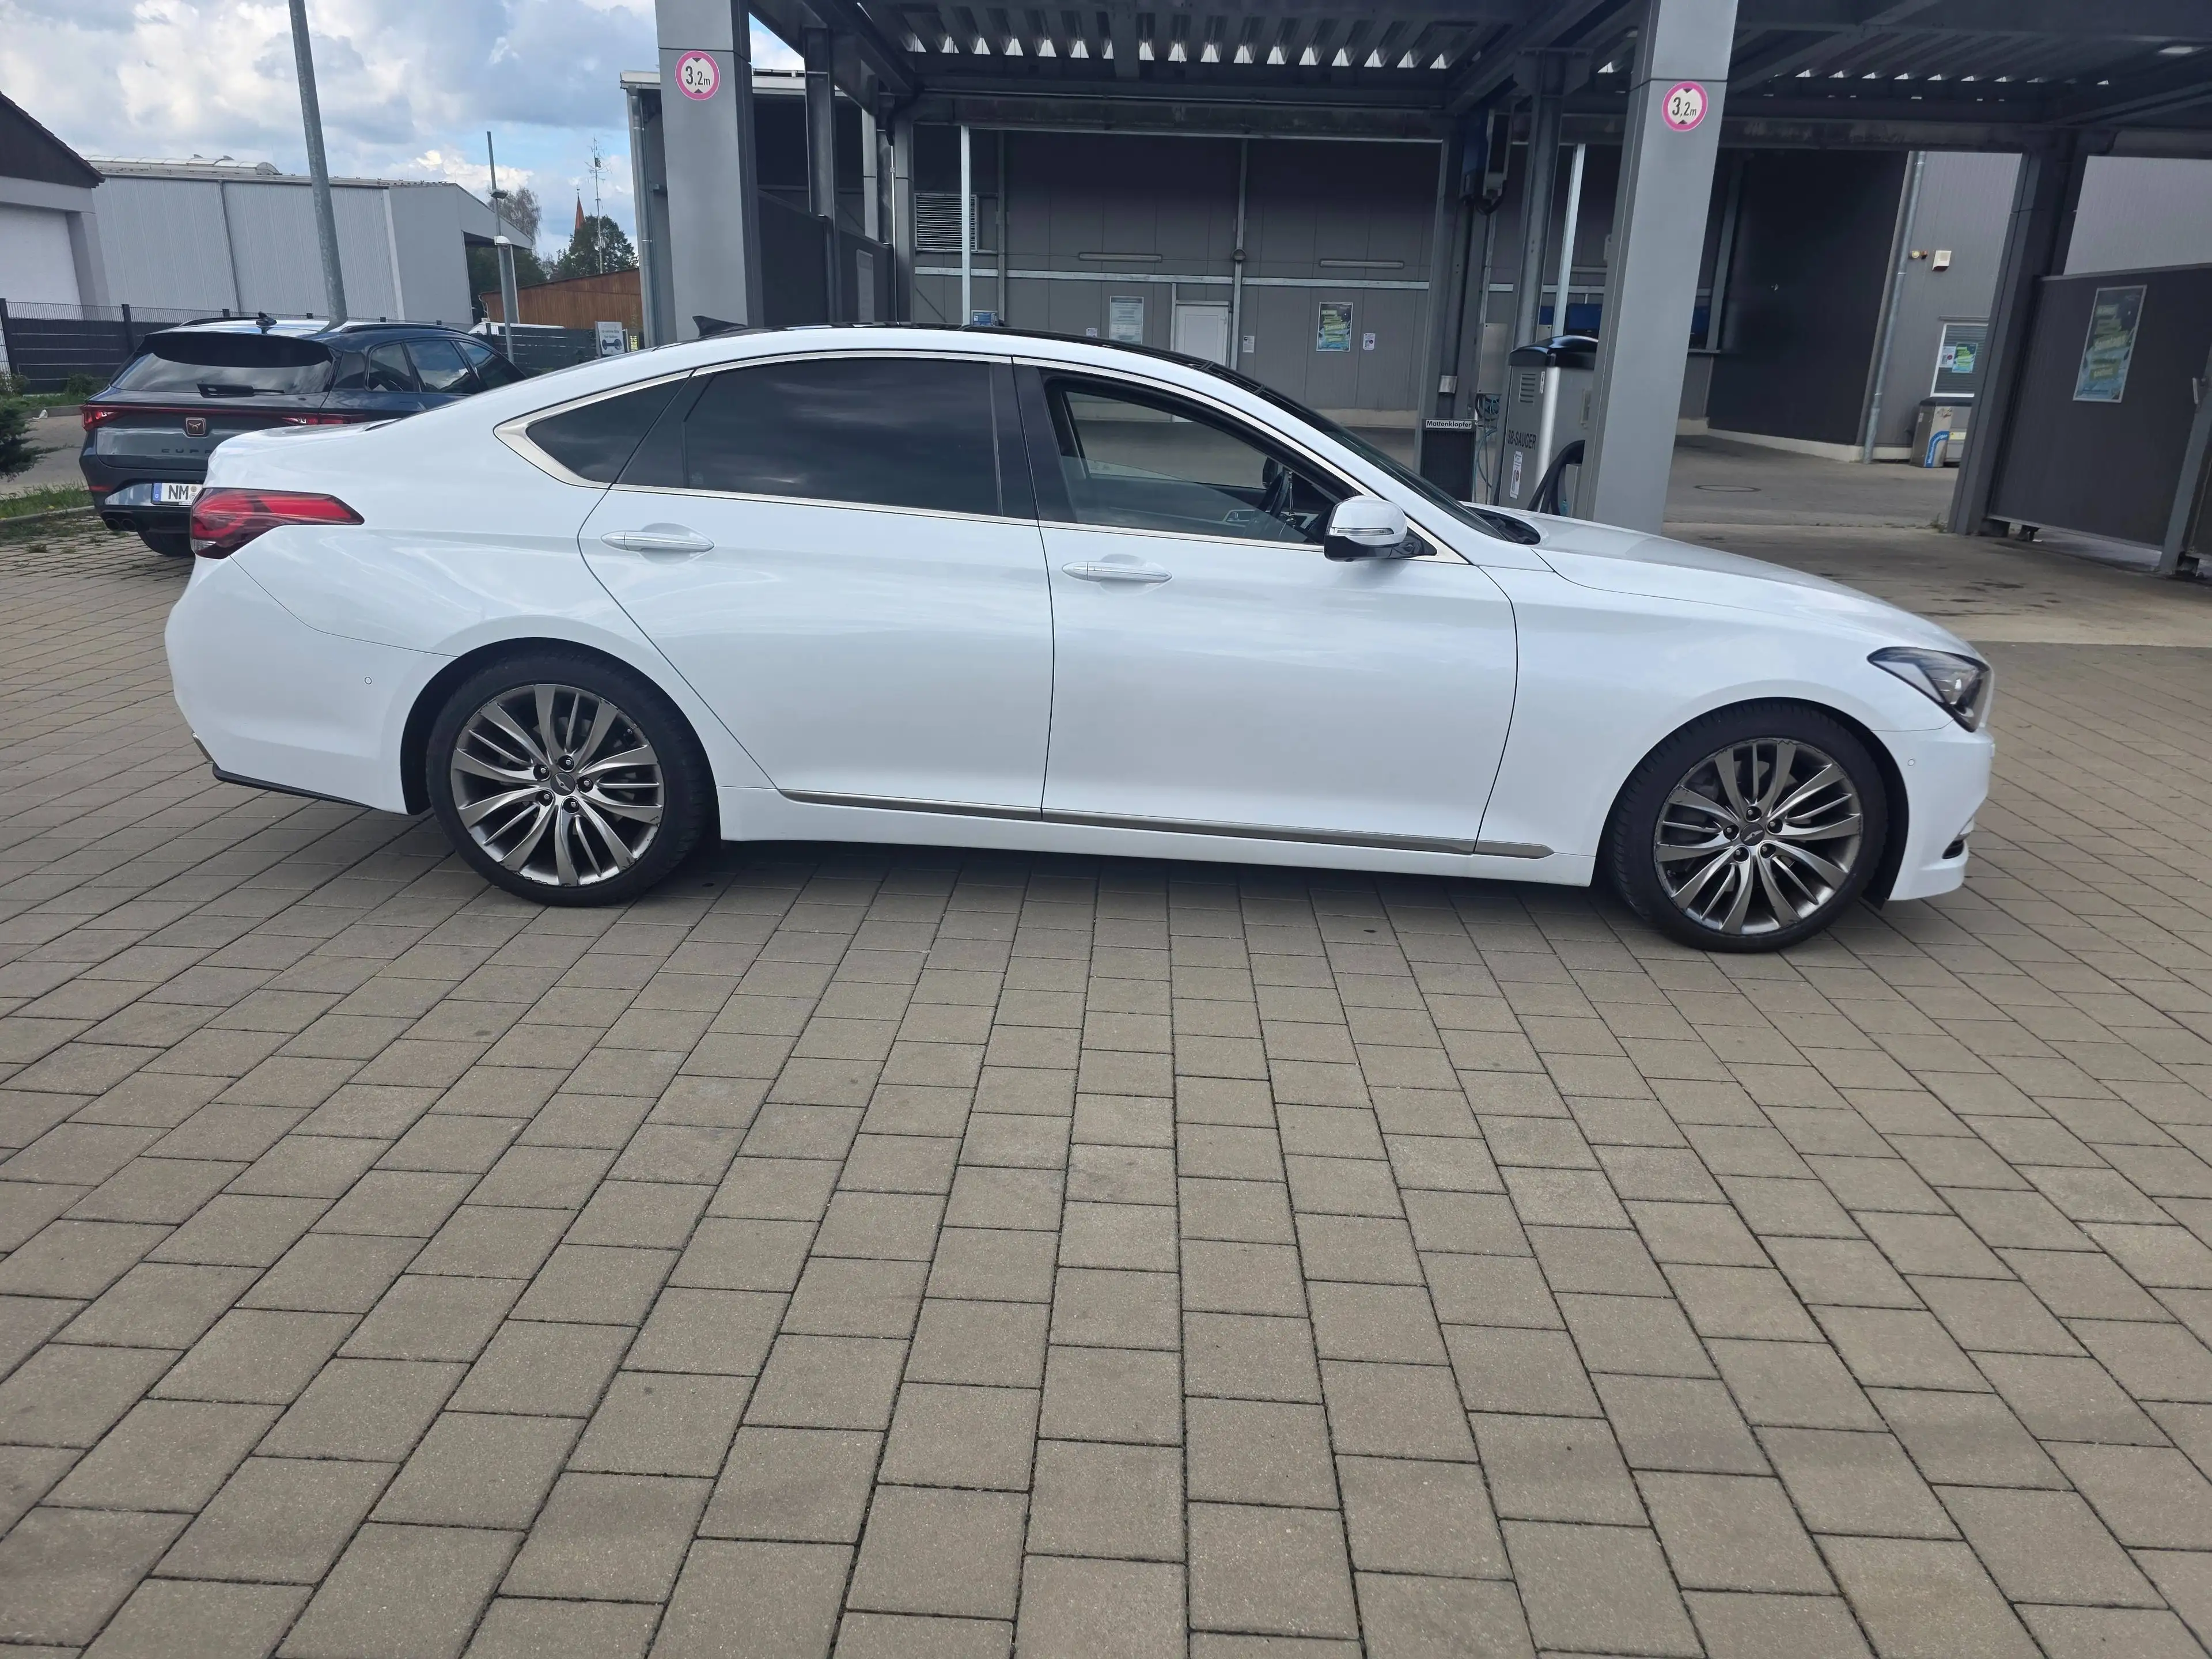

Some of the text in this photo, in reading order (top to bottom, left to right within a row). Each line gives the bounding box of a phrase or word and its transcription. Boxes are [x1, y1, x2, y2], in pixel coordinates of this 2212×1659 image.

[685, 65, 710, 86] 3,2m
[1672, 96, 1697, 118] 3,2m
[1508, 430, 1537, 450] SB-SAUGER
[168, 484, 190, 500] NM
